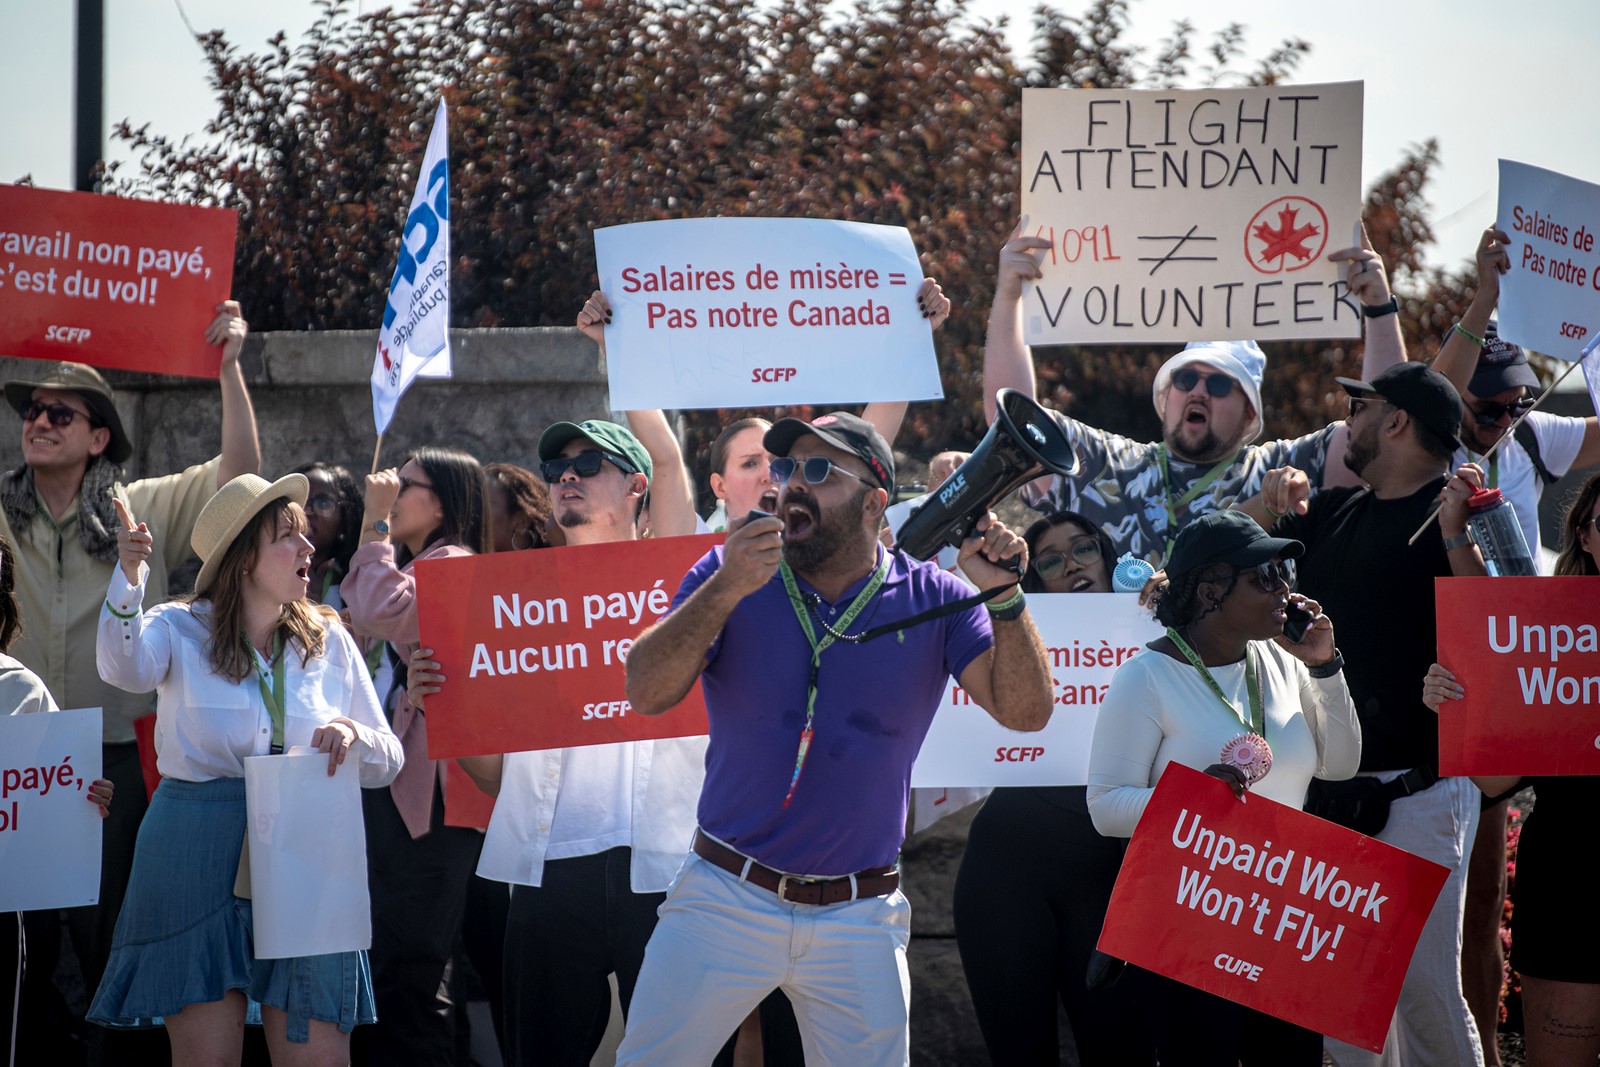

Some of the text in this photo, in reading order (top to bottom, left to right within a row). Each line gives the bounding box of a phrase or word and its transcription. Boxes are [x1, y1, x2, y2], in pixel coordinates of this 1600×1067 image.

[1087, 95, 1319, 148] FLIGHT
[1029, 144, 1338, 193] ATTENDANT
[1513, 205, 1594, 252] Salaires de
[77, 240, 130, 266] non
[137, 246, 212, 279] payé,
[621, 263, 735, 293] Salaires
[745, 263, 779, 290] de
[789, 261, 879, 290] misère
[1521, 243, 1545, 274] Pas
[1549, 257, 1587, 287] notre
[63, 269, 100, 299] du
[107, 277, 158, 304] vol!
[1035, 280, 1360, 328] VOLUNTEER
[646, 299, 890, 329] Pas notre Canada
[1560, 321, 1588, 341] SCFP
[45, 325, 91, 343] SCFP
[751, 367, 797, 383] SCFP
[492, 579, 669, 629] Non payé
[1487, 615, 1598, 662] Unpa
[469, 642, 588, 678] Aucun
[1517, 667, 1600, 705] Won
[582, 700, 632, 720] SCFP
[994, 747, 1045, 762] SCFP
[3, 756, 83, 798] payé,
[1171, 808, 1389, 922] Unpaid Work
[1175, 865, 1345, 962] Won’t Fly!
[1213, 953, 1264, 982] CUPE
